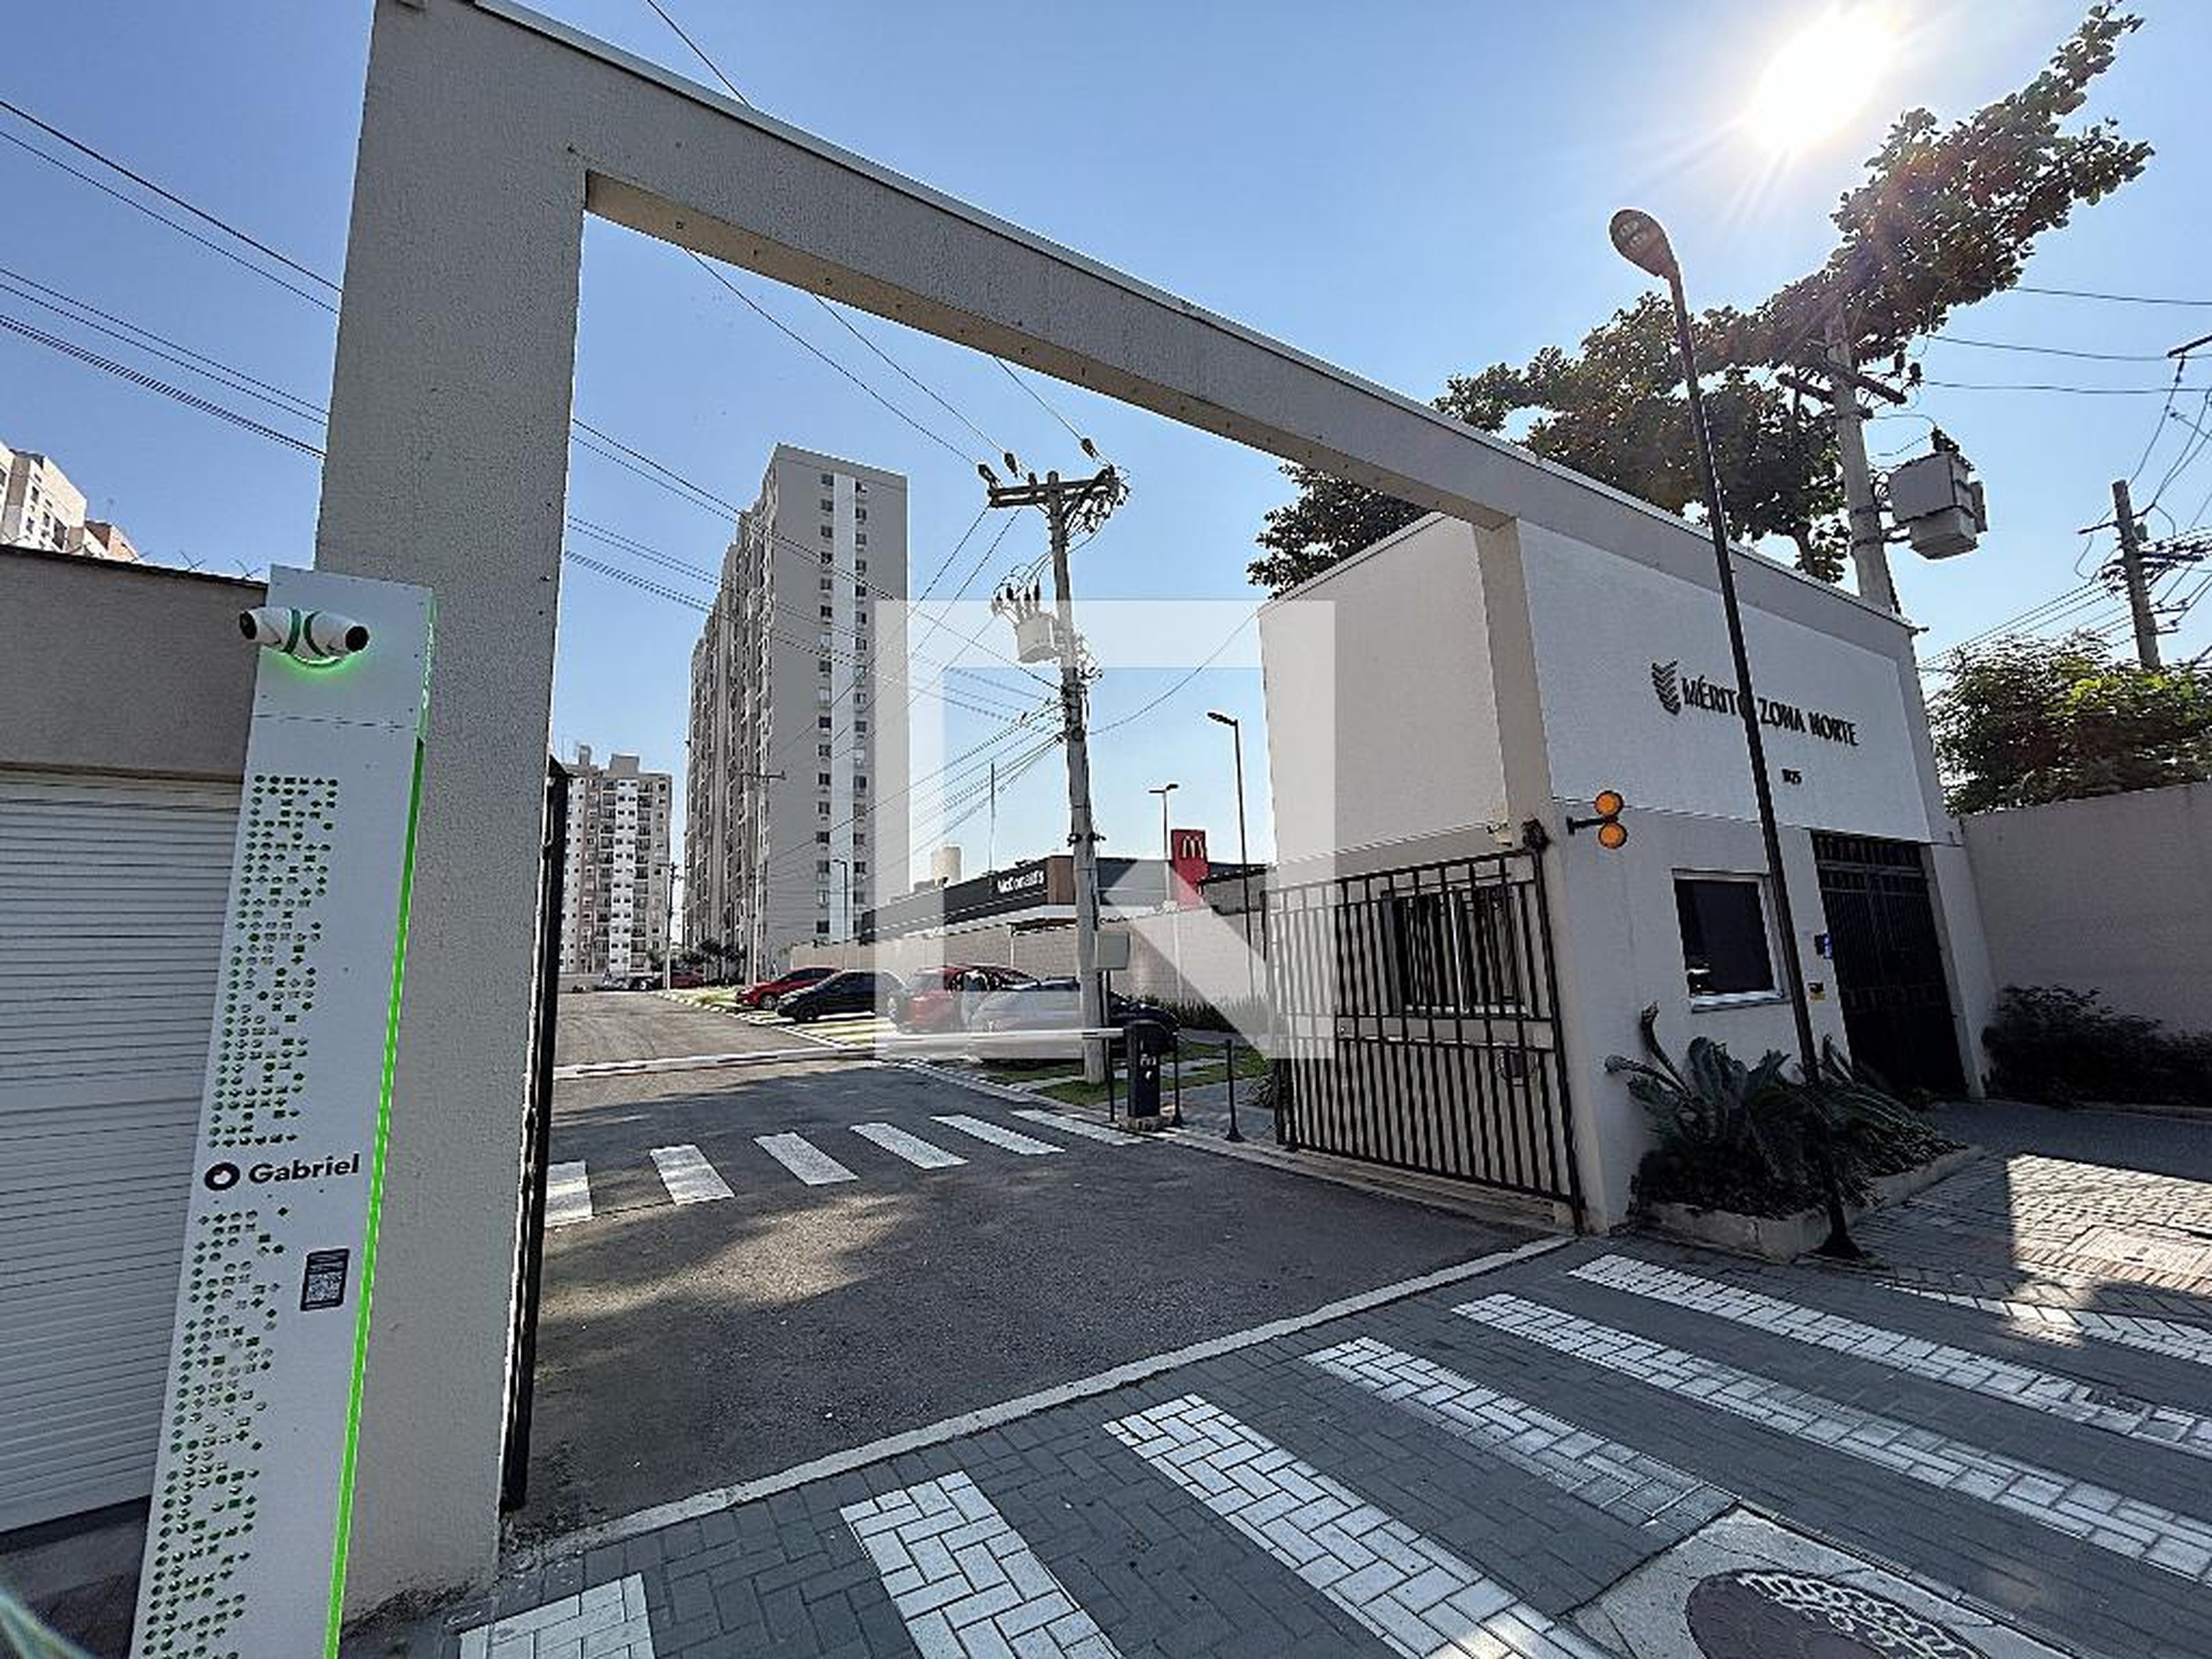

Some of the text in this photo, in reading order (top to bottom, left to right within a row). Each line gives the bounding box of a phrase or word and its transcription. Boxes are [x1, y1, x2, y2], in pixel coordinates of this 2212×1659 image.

[1681, 675, 1859, 746] MÉRIT ZONA NORTE
[248, 1153, 359, 1184] Gabriel
